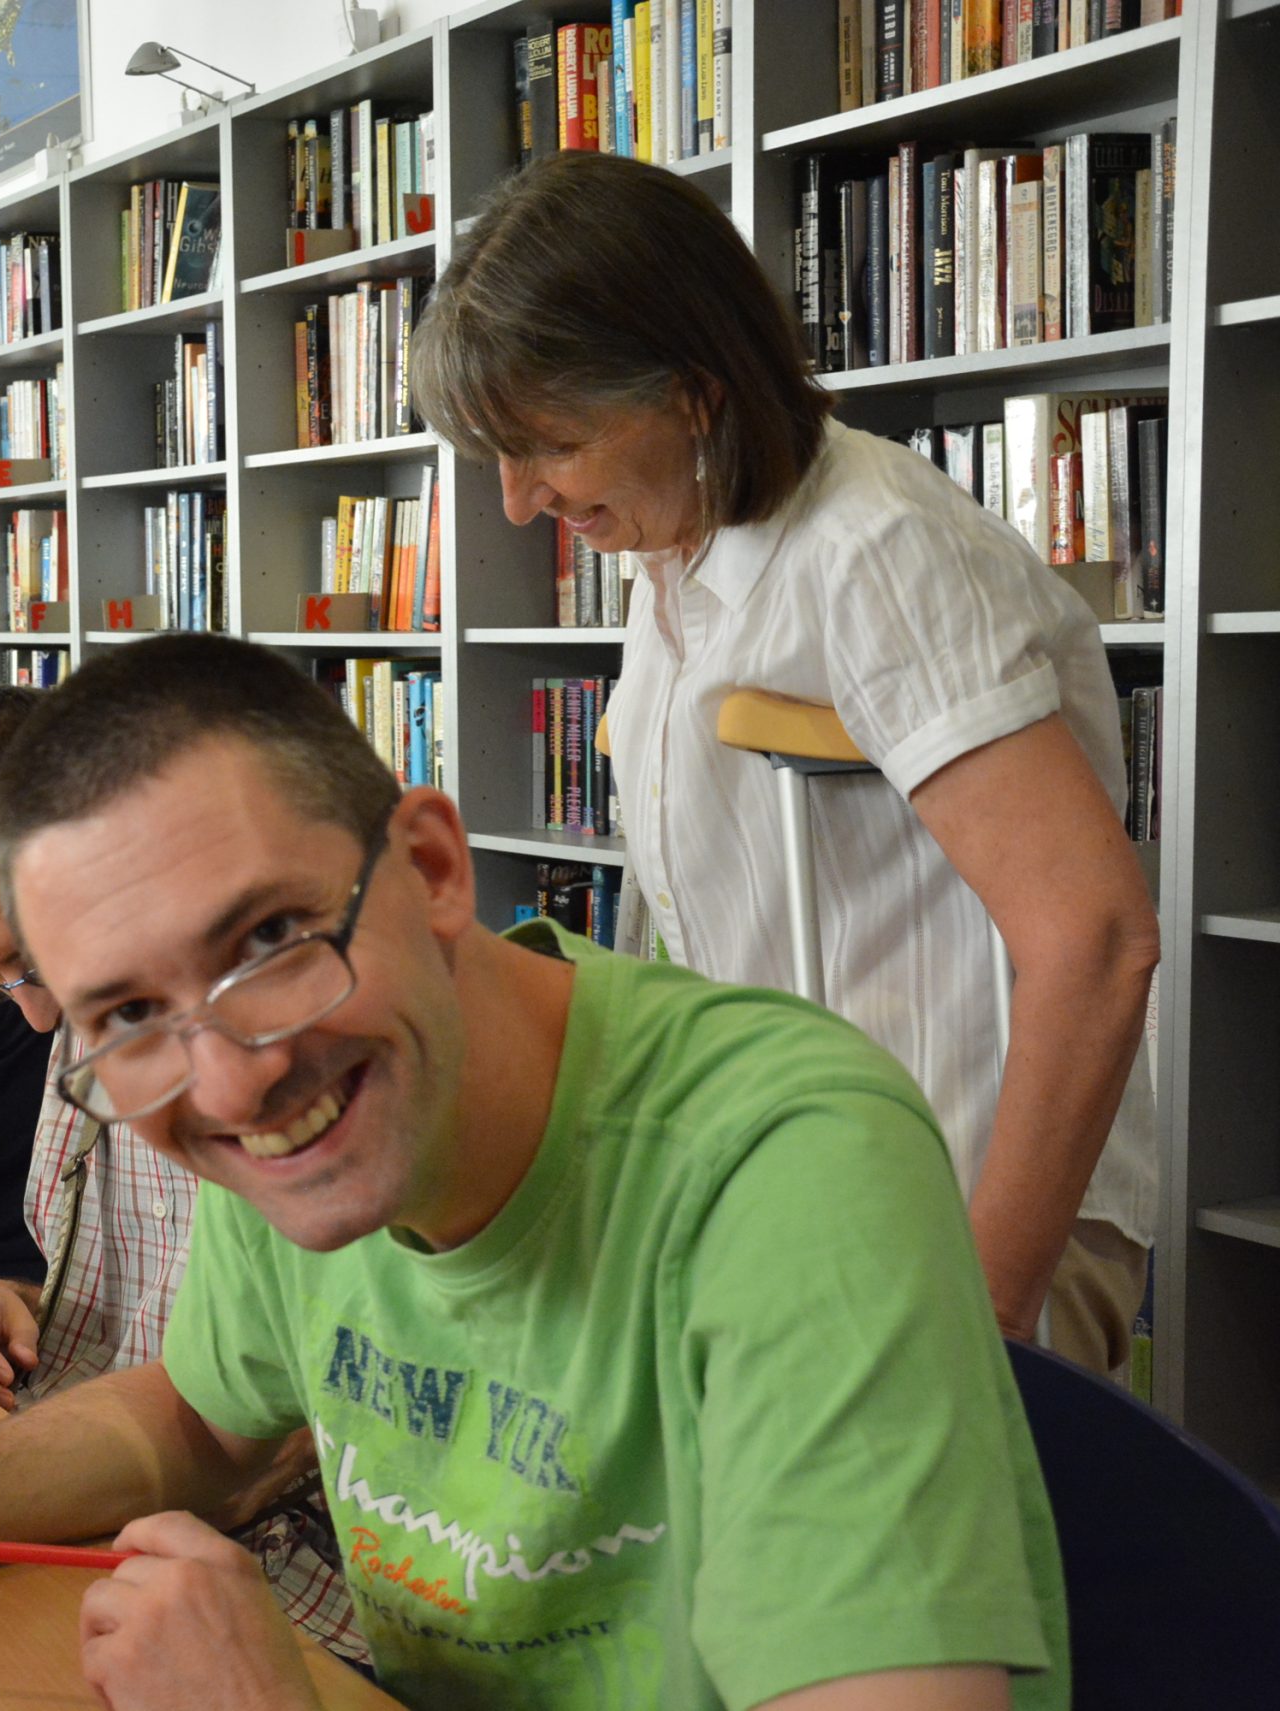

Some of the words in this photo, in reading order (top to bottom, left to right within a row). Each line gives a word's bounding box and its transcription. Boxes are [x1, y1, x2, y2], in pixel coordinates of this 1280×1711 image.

[566, 28, 577, 72] ROBERT
[567, 73, 578, 119] LUDLUM
[615, 79, 625, 113] HEAD
[940, 169, 951, 193] Toni
[406, 196, 433, 234] J
[802, 190, 819, 255] BLIND
[940, 195, 951, 236] Morrison
[1045, 185, 1059, 253] MONTENEGRO
[933, 249, 952, 285] JAZZ
[802, 256, 819, 324] FAITH
[31, 603, 46, 631] F
[108, 599, 133, 630] H
[305, 596, 331, 630] K
[566, 687, 582, 721] HENRY
[566, 723, 582, 762] MILLER
[566, 786, 582, 825] PLEXUS
[323, 1325, 469, 1444] NEW
[401, 1619, 612, 1656] DEPARTMENT
